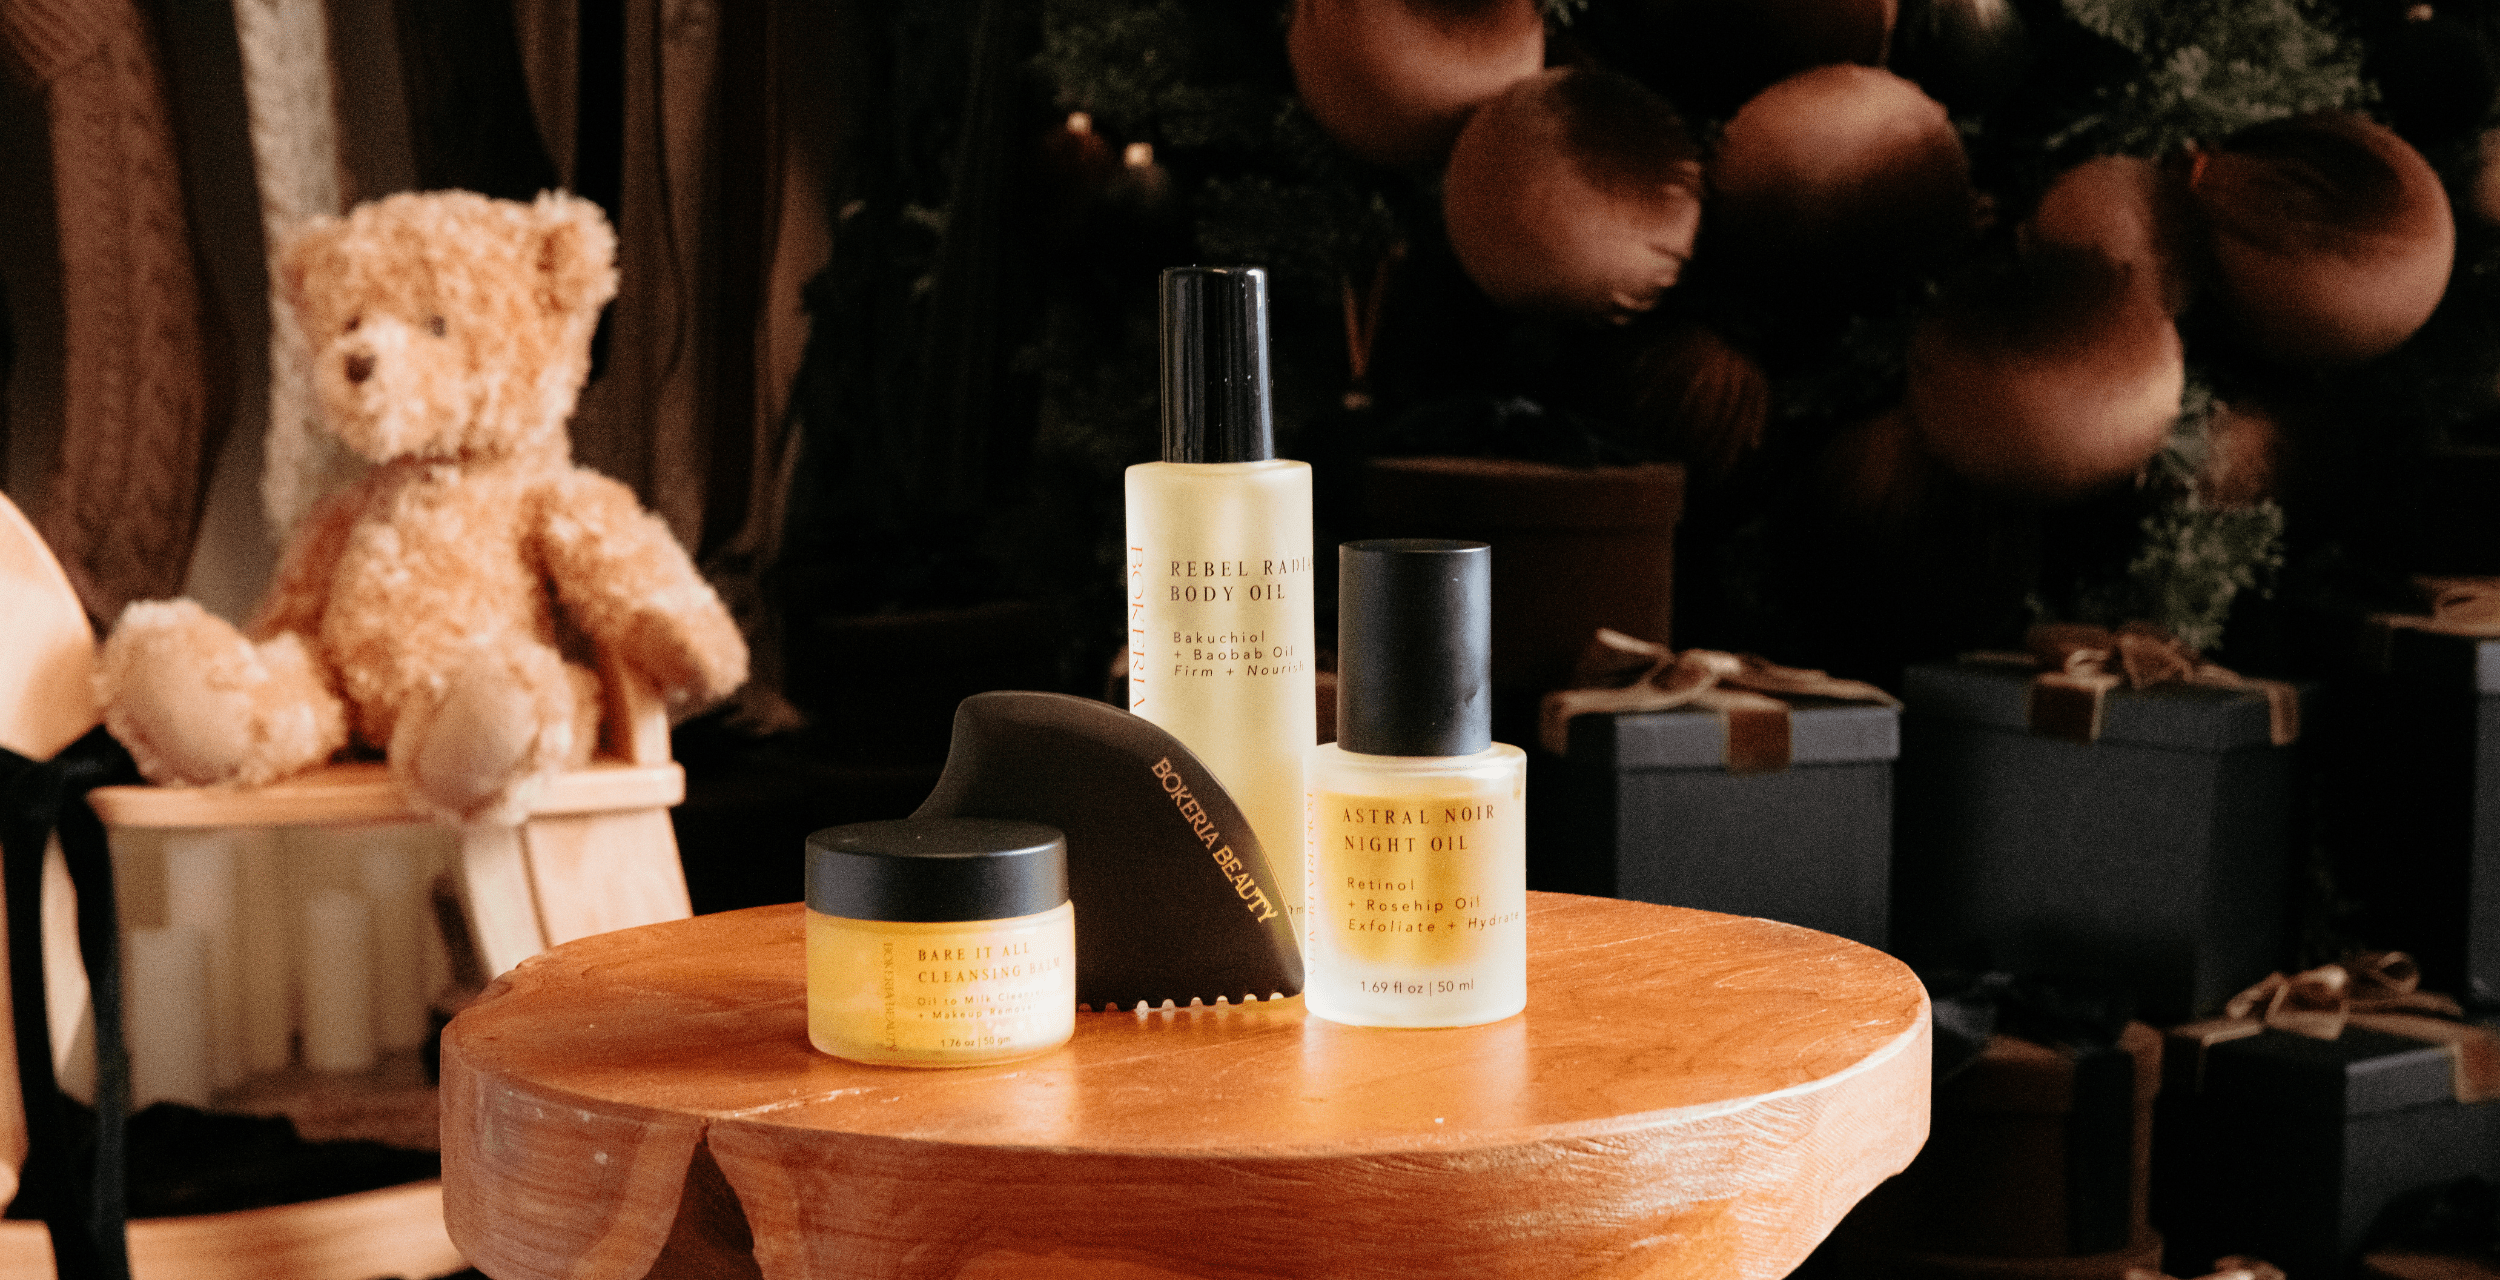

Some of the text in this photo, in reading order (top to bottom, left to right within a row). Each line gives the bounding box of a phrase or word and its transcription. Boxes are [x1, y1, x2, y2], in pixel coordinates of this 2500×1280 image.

[1171, 560, 1249, 577] REBEL
[1170, 583, 1286, 602] BODY OIL
[1131, 546, 1146, 709] BOKERIA
[1173, 630, 1265, 644] Bakuchiol
[1193, 648, 1263, 661] Baobab
[1272, 645, 1294, 659] Oil
[1174, 664, 1214, 677] Firm
[1246, 660, 1304, 677] Nourish
[1343, 804, 1495, 825] ASTRAL NOIR
[1151, 757, 1279, 924] BOKERIA BEAUTY
[1344, 834, 1468, 853] NIGHT OIL
[1347, 877, 1415, 891] Retinol
[1367, 898, 1443, 914] Rosehip
[1455, 894, 1481, 910] Oil
[1348, 918, 1436, 933] Exfoliate
[1468, 910, 1520, 930] Hydrate
[917, 942, 1031, 962] BARE IT ALL
[918, 966, 1021, 983] CLEANSING
[1360, 981, 1388, 994] 1.69
[1393, 980, 1403, 994] fl
[1407, 983, 1424, 994] oz
[1437, 980, 1454, 993] 50
[1459, 978, 1475, 992] ml
[917, 997, 937, 1007] Oil
[944, 998, 957, 1006] to
[964, 994, 991, 1005] Milk
[932, 1010, 983, 1020] Makeup
[964, 1039, 976, 1047] oz
[984, 1036, 996, 1046] 50
